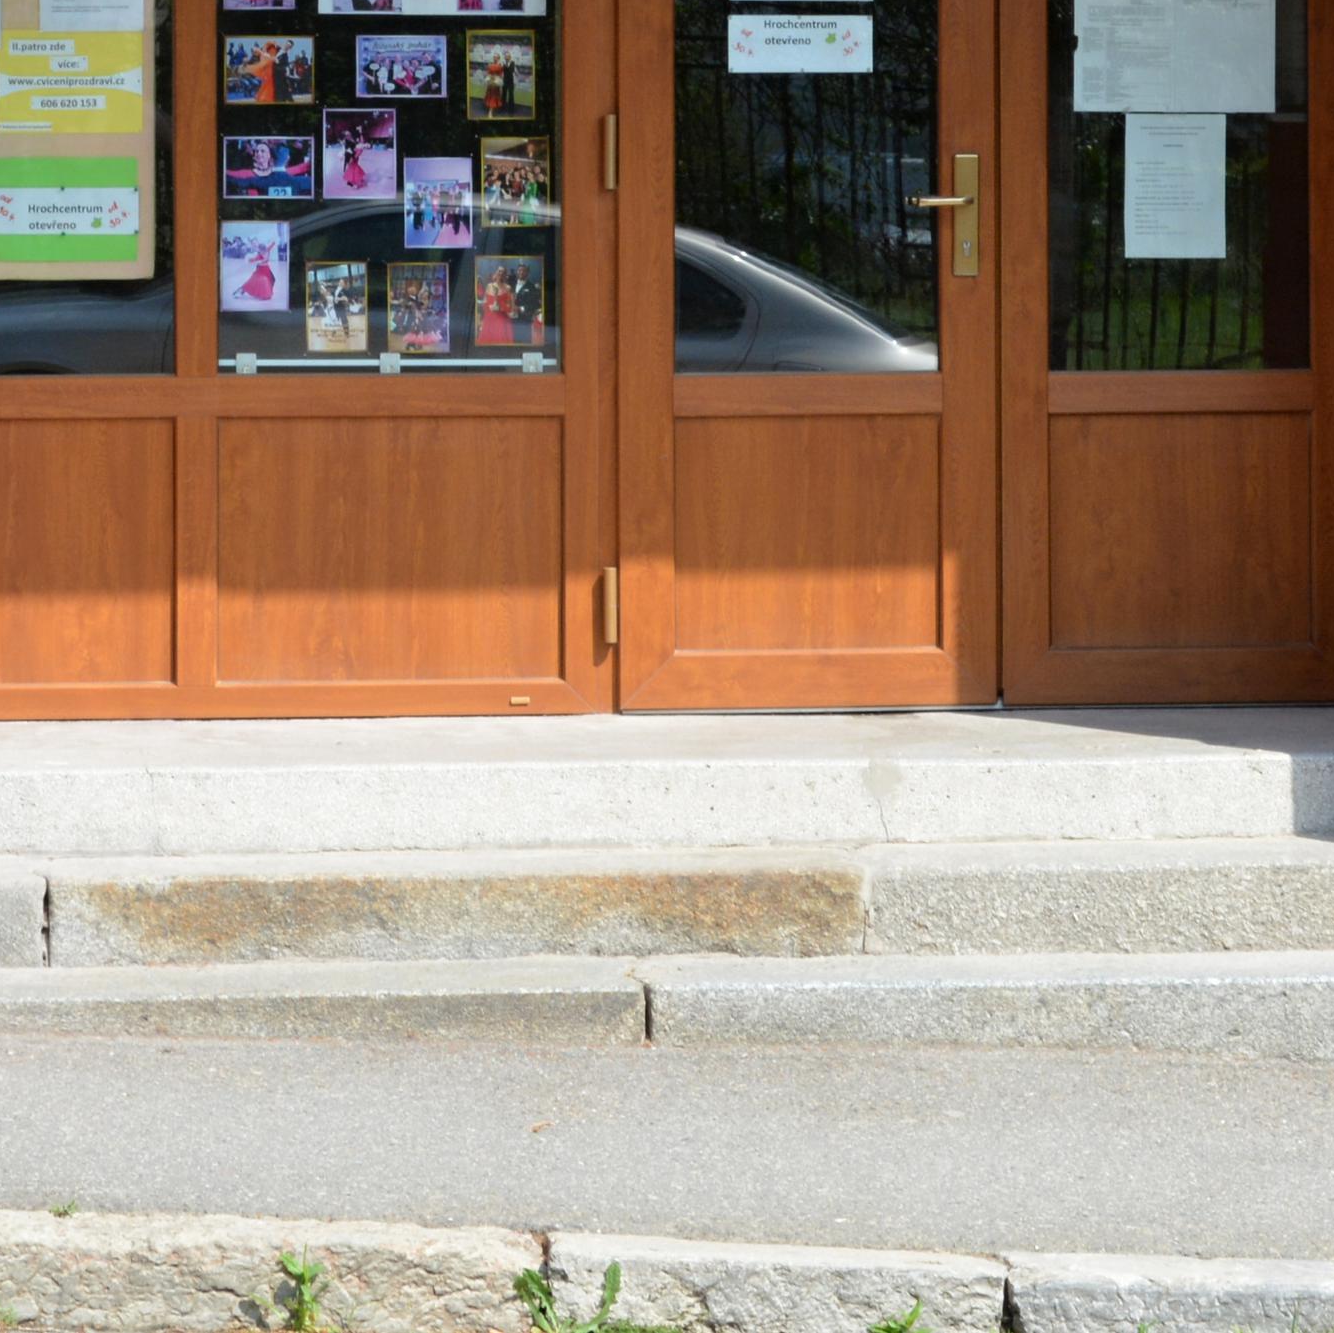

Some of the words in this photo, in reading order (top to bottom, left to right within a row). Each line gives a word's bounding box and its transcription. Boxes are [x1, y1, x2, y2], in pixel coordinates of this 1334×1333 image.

[764, 20, 837, 29] Hrochcentrum
[765, 36, 811, 45] otevřeno
[50, 42, 66, 52] zde
[40, 99, 58, 108] 606
[60, 99, 78, 108] 620
[81, 98, 97, 108] 153
[28, 204, 104, 214] Hrochcentrum
[29, 220, 77, 230] otevřeno
